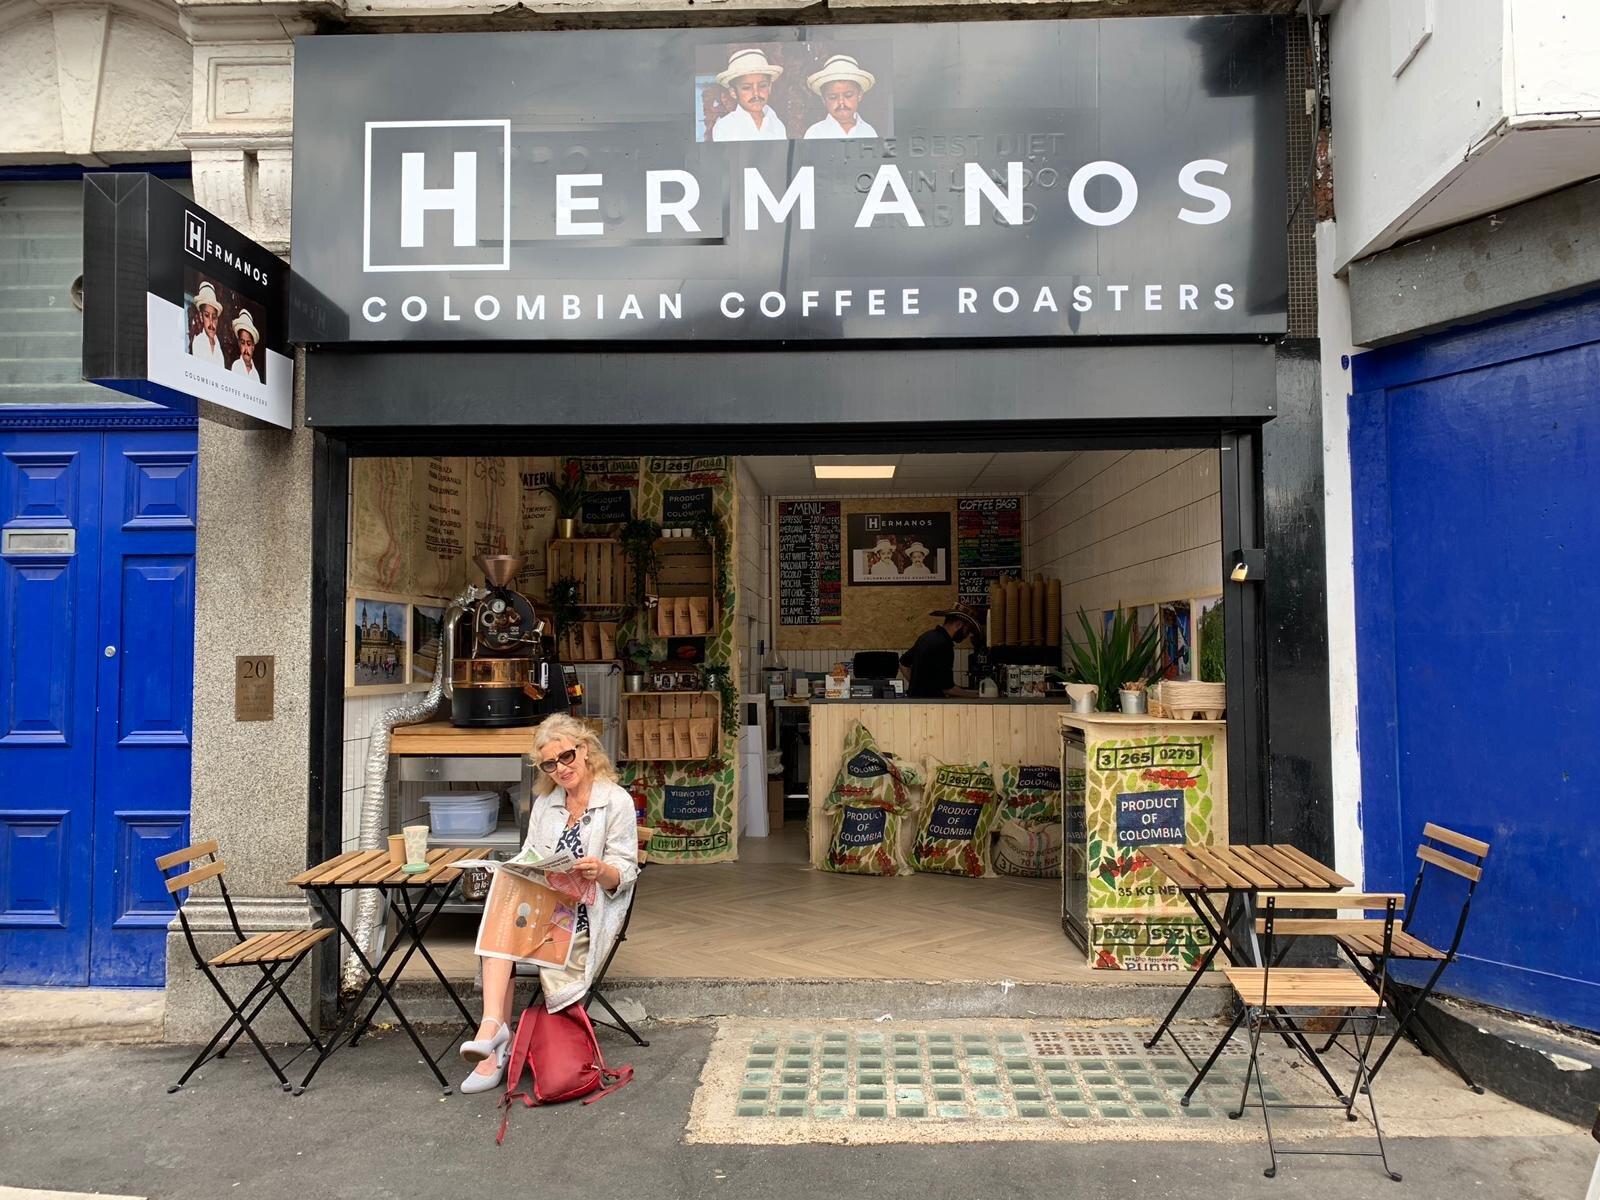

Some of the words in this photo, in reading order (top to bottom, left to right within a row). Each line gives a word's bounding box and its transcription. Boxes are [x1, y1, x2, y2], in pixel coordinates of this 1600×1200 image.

[401, 152, 1231, 248] HERMANOS
[189, 221, 268, 286] HERMANOS
[363, 294, 683, 323] COLOMBIAN
[720, 288, 921, 319] COFFEE
[958, 283, 1234, 314] ROASTERS
[668, 494, 705, 502] PRODUCT
[960, 499, 994, 510] COFFEE
[995, 499, 1017, 510] BAGS
[869, 517, 933, 529] HERMANOS
[243, 660, 267, 679] 20
[1101, 755, 1111, 766] 3
[1120, 751, 1151, 765] 265
[1159, 746, 1195, 760] 0279
[939, 773, 945, 781] 3
[949, 776, 969, 785] 265
[670, 790, 711, 798] COLOMBIA
[937, 804, 980, 816] PRODUCT
[1121, 797, 1178, 812] PRODUCT
[947, 817, 960, 825] OF
[1141, 813, 1158, 826] OF
[857, 823, 870, 832] OF
[929, 824, 973, 836] COLOMBIA
[840, 831, 882, 843] COLOMBIA
[1119, 827, 1183, 842] COLOMBIA
[688, 838, 711, 847] 265
[1118, 885, 1133, 897] 35
[1136, 884, 1155, 897] KG
[1150, 927, 1185, 940] 265
[1196, 928, 1207, 939] 3
